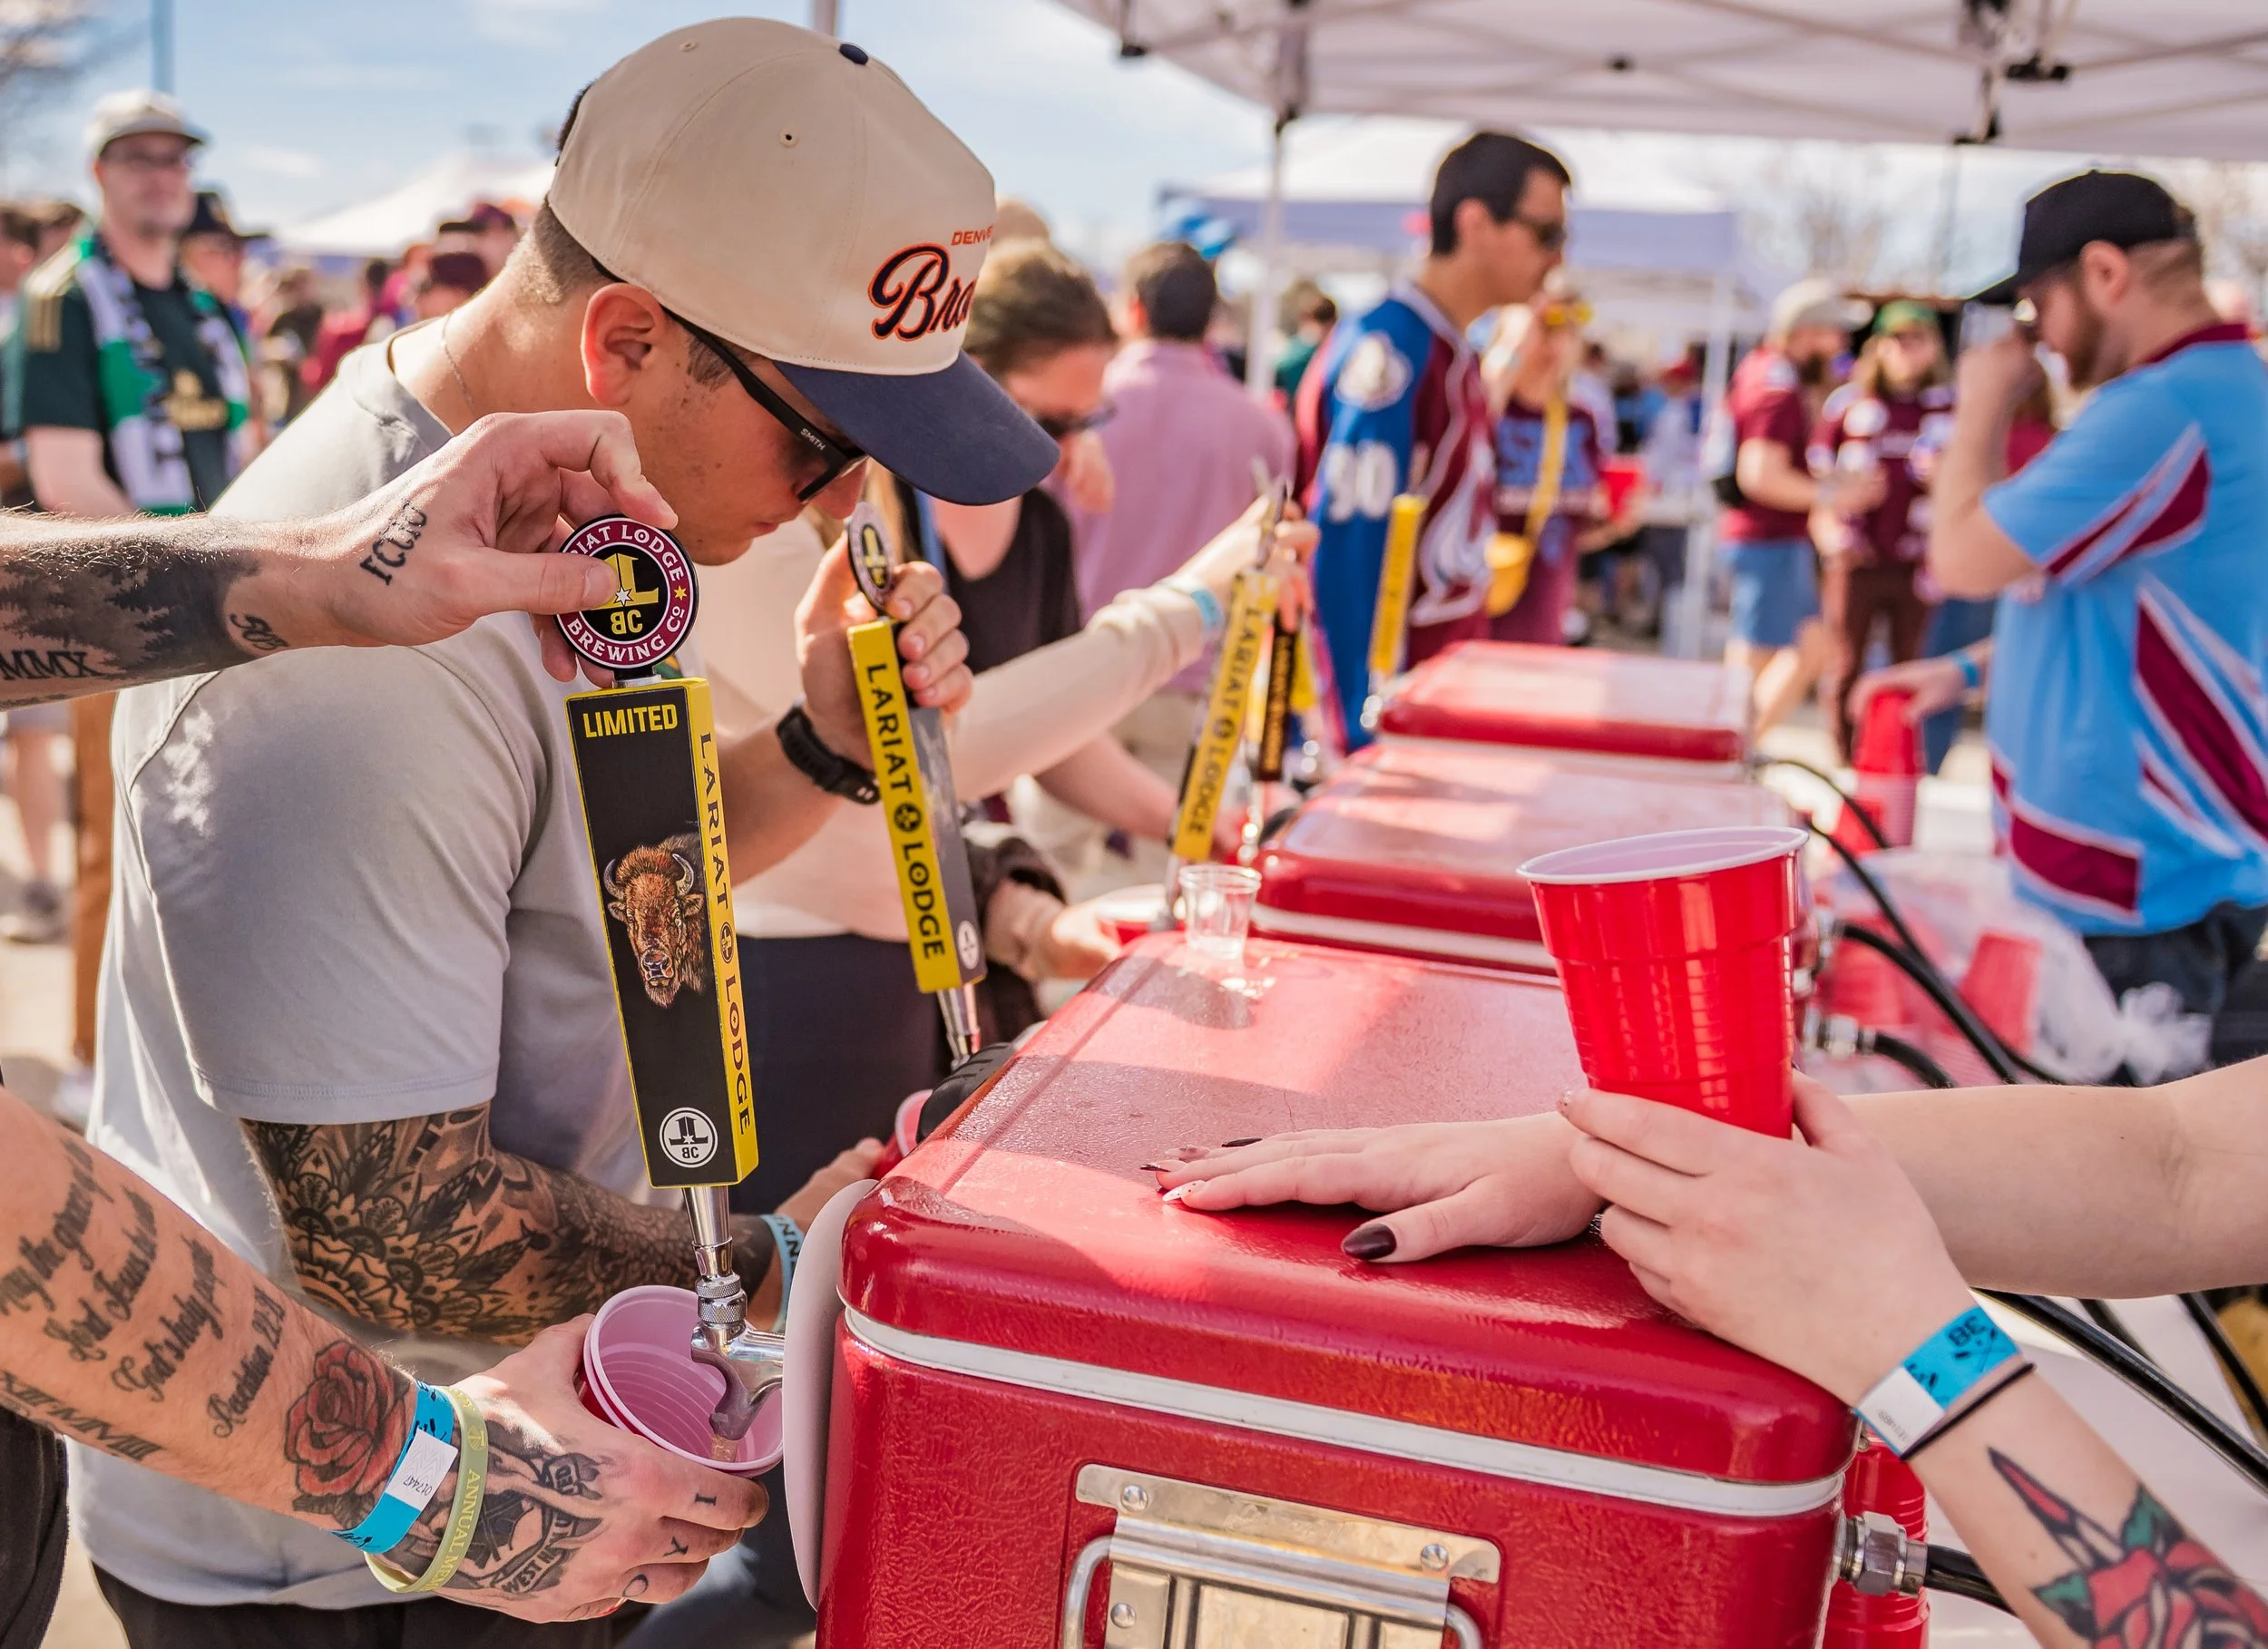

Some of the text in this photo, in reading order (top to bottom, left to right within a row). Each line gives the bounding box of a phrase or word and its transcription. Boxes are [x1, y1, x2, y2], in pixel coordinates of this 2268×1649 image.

[799, 427, 826, 452] SMITH
[621, 524, 684, 581] LODGE
[567, 619, 667, 662] BREWING
[582, 704, 678, 738] LIMITED
[865, 663, 946, 959] LARIAT LODGE
[699, 731, 730, 910] LARIAT
[725, 976, 756, 1136] LODGE
[403, 1476, 432, 1497] 017447
[450, 1468, 482, 1553] ANNUAL
[501, 1562, 543, 1595] WEST
